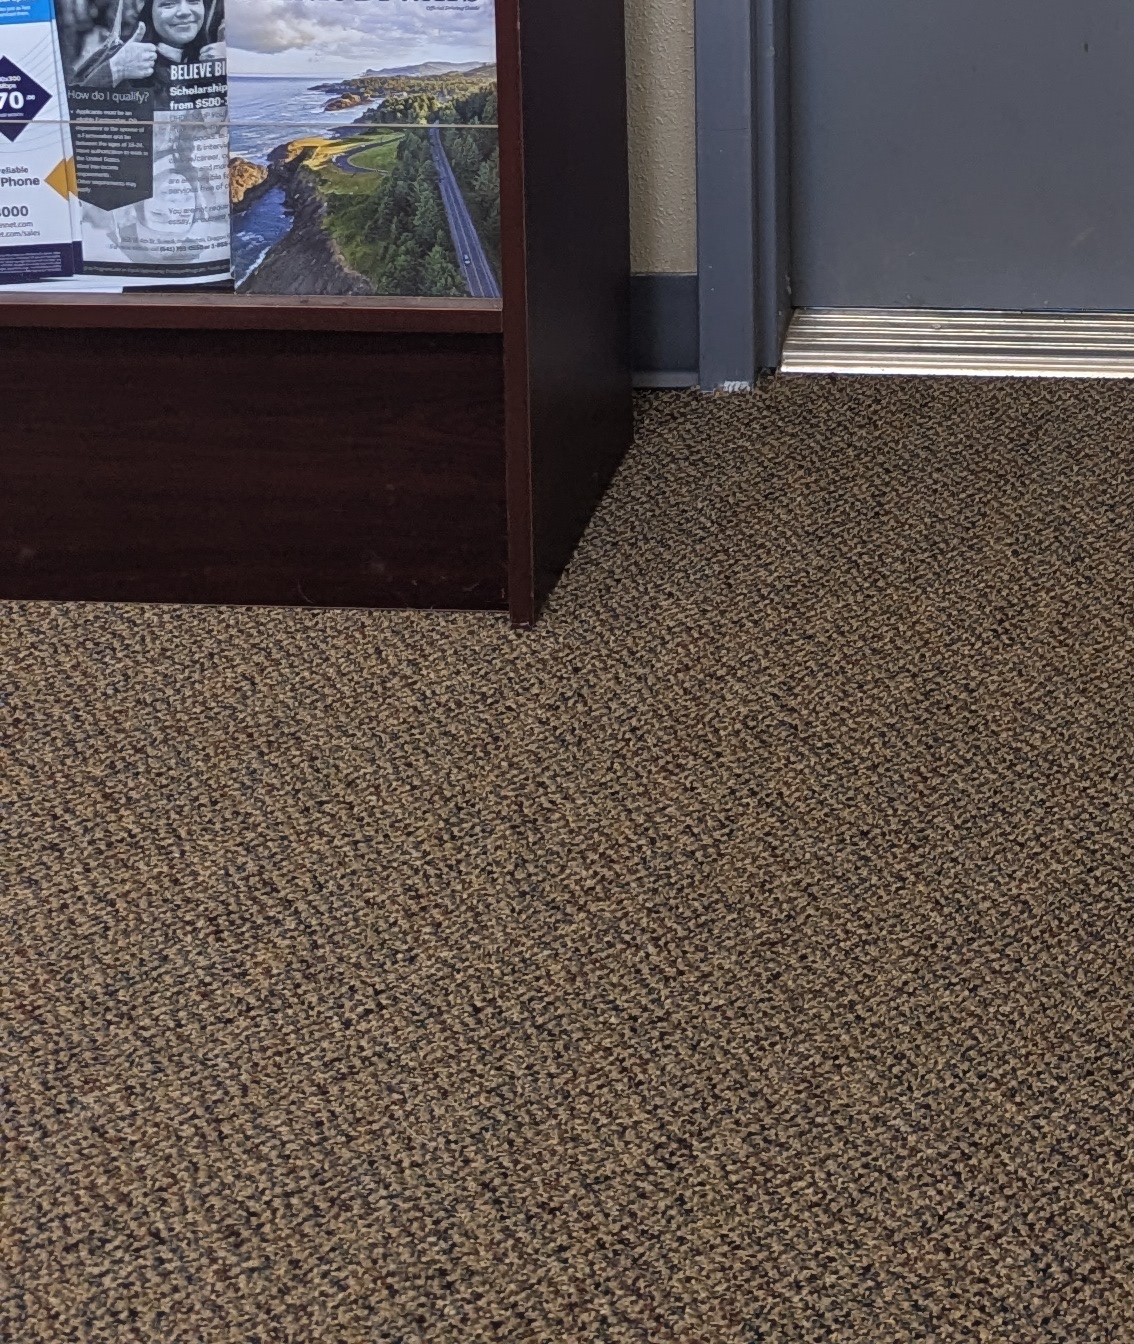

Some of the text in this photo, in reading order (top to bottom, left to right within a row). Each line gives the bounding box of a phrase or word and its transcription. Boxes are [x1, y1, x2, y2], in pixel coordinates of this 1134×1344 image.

[170, 62, 212, 80] BELIEVE
[68, 90, 89, 100] How
[92, 91, 104, 100] do
[112, 91, 149, 104] qualify?
[170, 101, 193, 110] from
[1, 177, 40, 187] Phone
